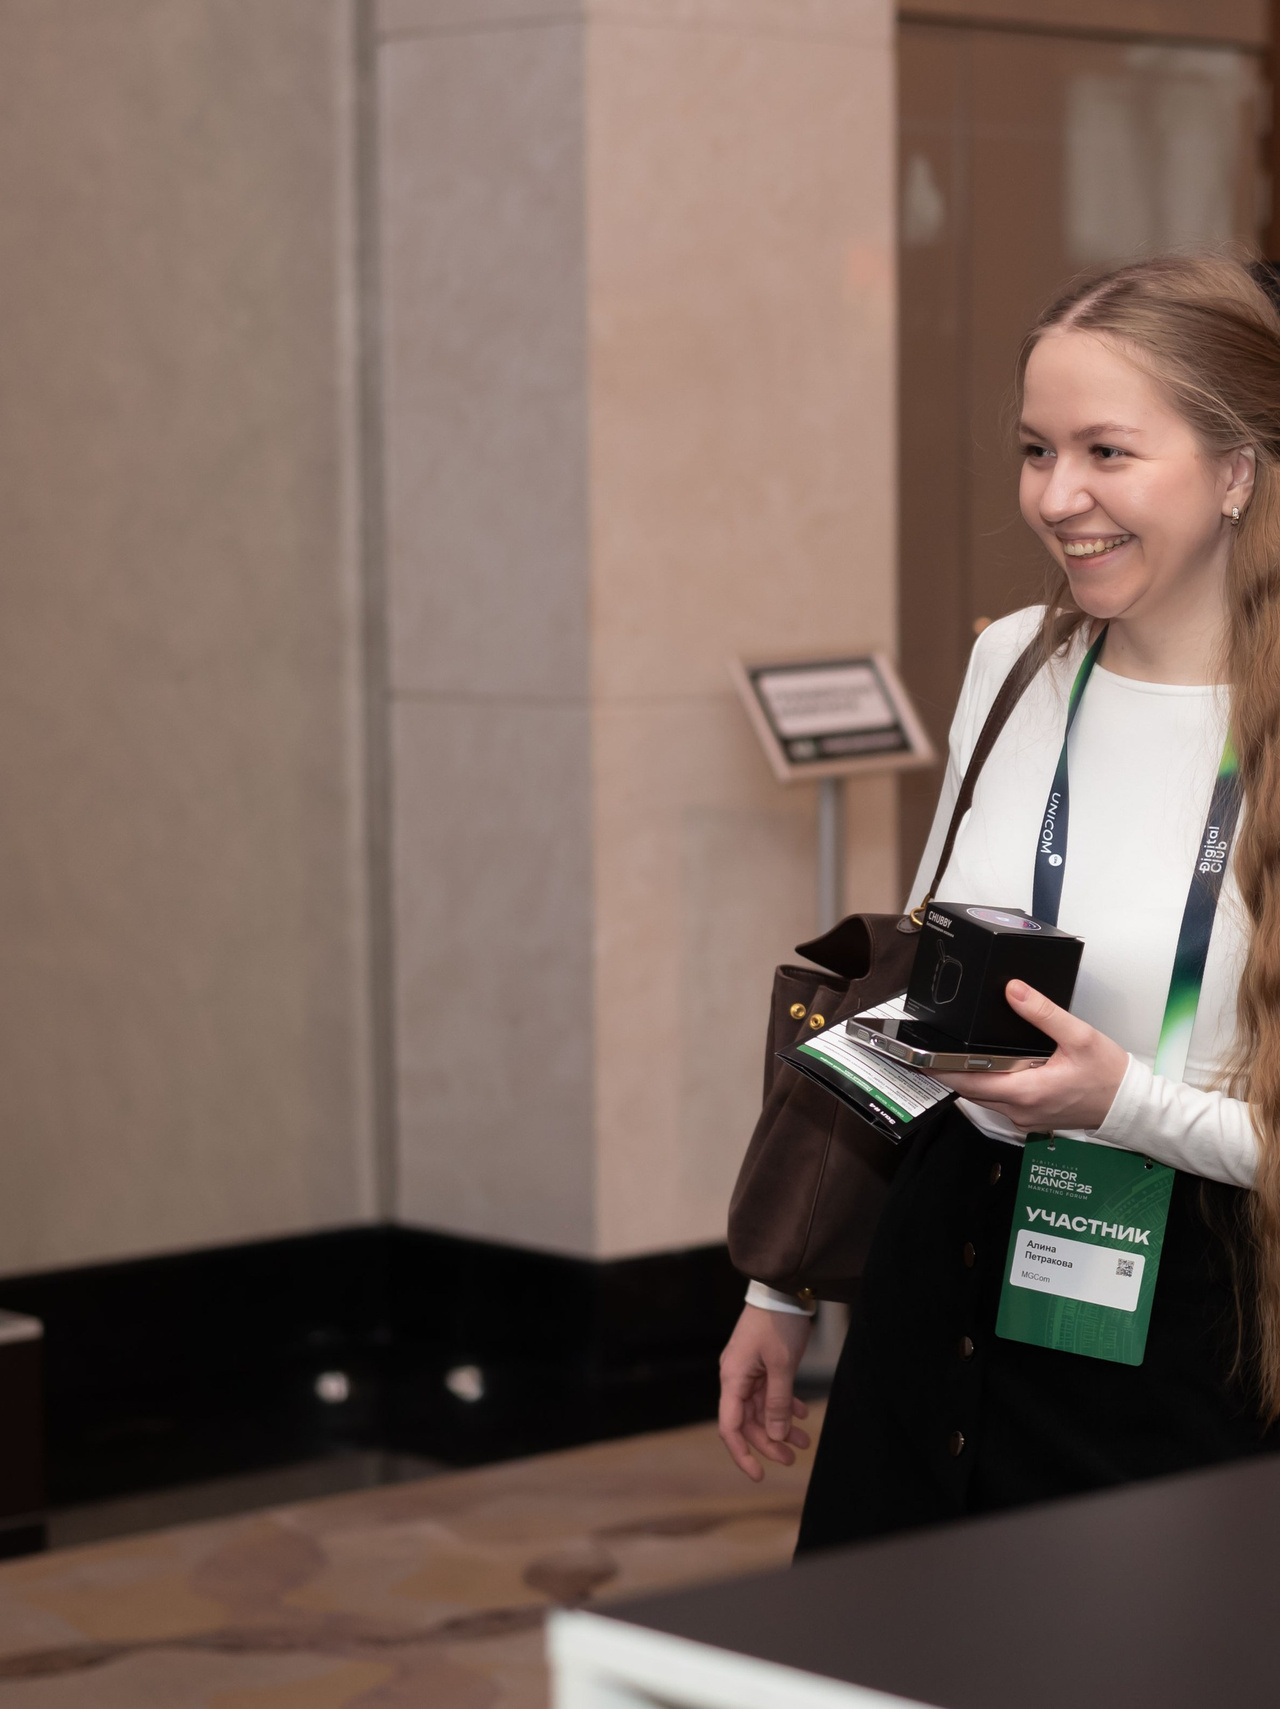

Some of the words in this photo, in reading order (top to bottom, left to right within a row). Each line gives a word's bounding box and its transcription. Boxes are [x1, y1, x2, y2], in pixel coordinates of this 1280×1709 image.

[1040, 792, 1061, 854] UNICOM
[1199, 825, 1220, 874] Digital
[1210, 840, 1228, 873] Club
[928, 910, 953, 929] CHUBBY
[1030, 1164, 1078, 1182] PERFOR
[1027, 1184, 1064, 1196] MARKETING
[1065, 1191, 1088, 1201] FORUM
[1029, 1173, 1093, 1195] MANCE'25
[1025, 1205, 1151, 1246] УЧАСТНИК
[1026, 1239, 1057, 1254] Алина
[1024, 1250, 1073, 1269] Петракова
[1021, 1270, 1051, 1284] MGCom
